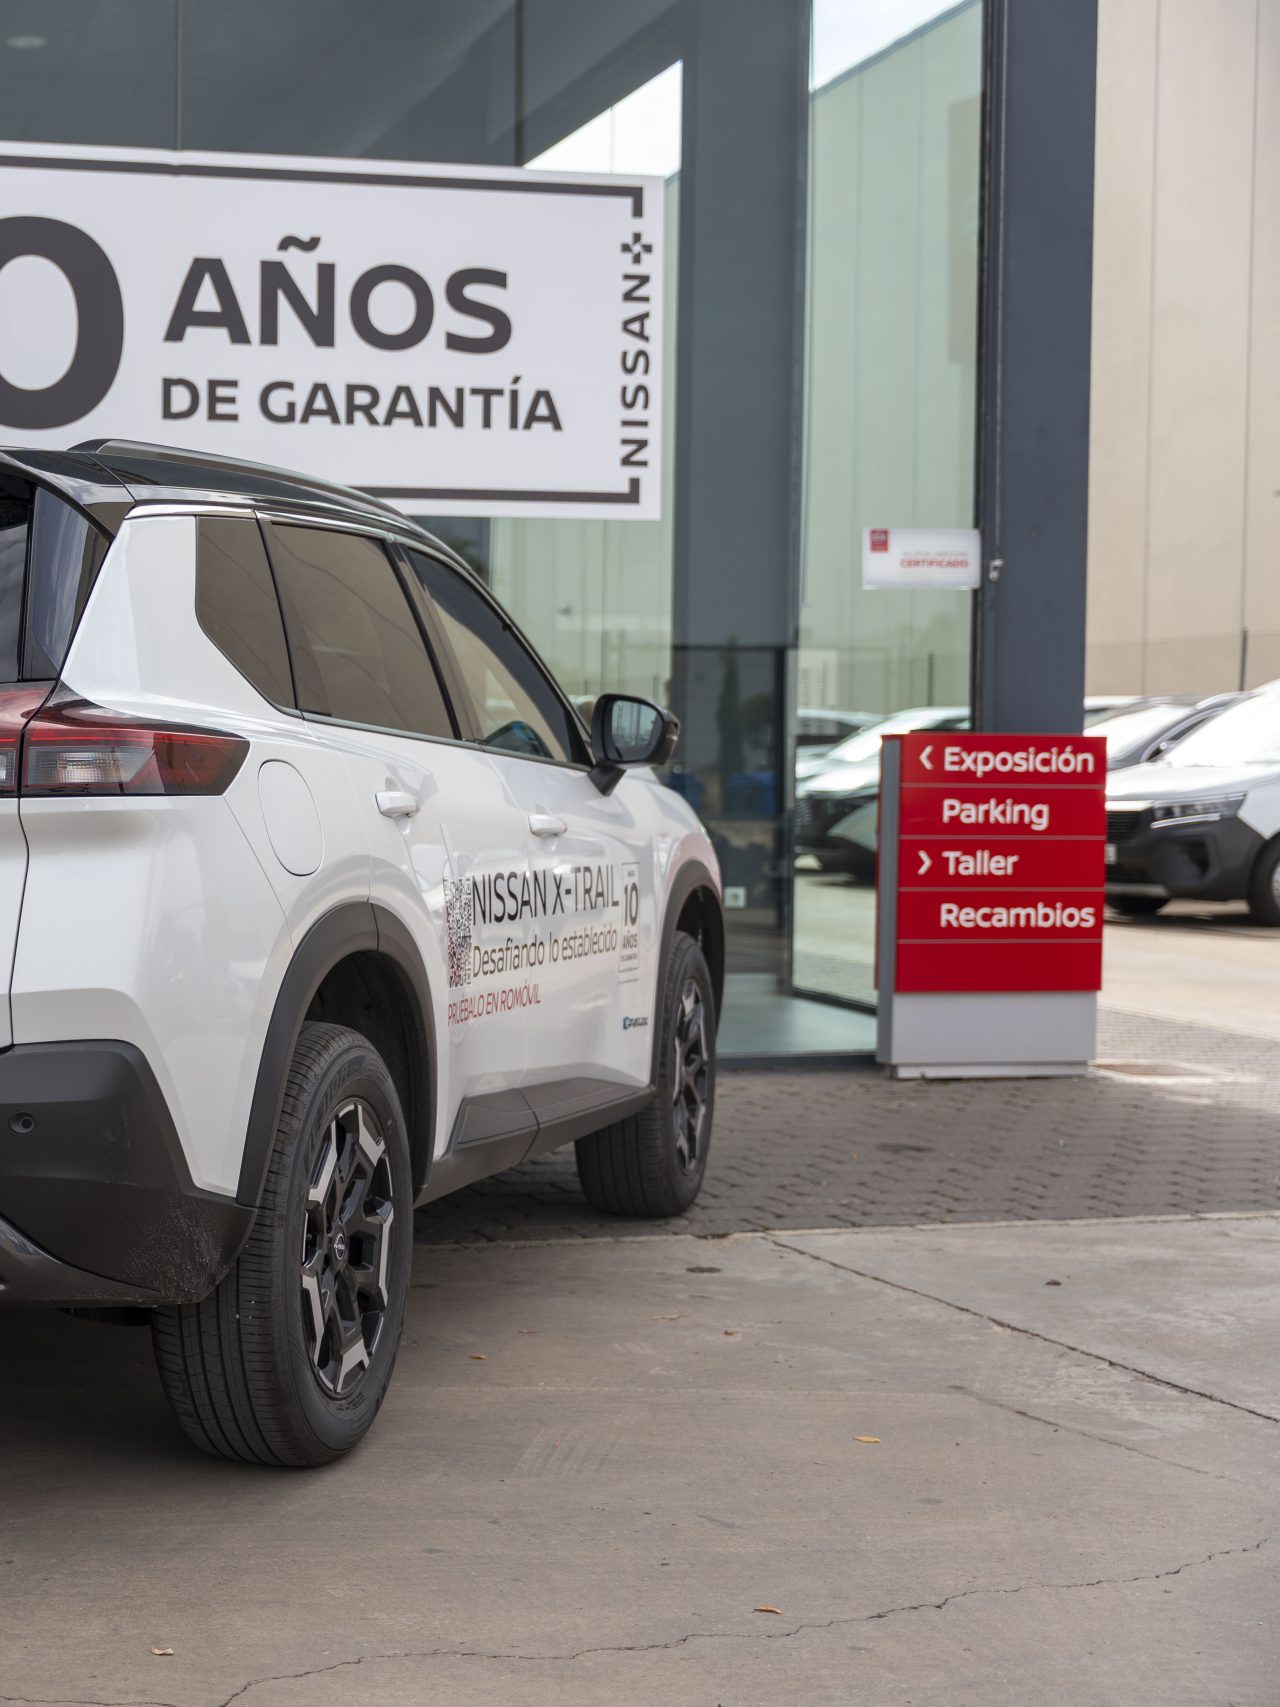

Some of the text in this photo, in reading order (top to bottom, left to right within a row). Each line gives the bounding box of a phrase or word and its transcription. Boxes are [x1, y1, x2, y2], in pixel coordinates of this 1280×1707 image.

[163, 236, 512, 355] AÑOS
[162, 376, 563, 431] DE GARANTÍA
[943, 745, 1095, 778] Exposición
[942, 798, 1050, 831] Parking
[942, 849, 1019, 876] Taller
[472, 864, 619, 926] NISSAN X-TRAIL
[624, 882, 639, 927] 10
[940, 902, 1096, 929] Recambios
[472, 922, 618, 978] Desafiando lo establecido
[447, 979, 541, 1027] PRUÉBALO EN ROMÓVIL
